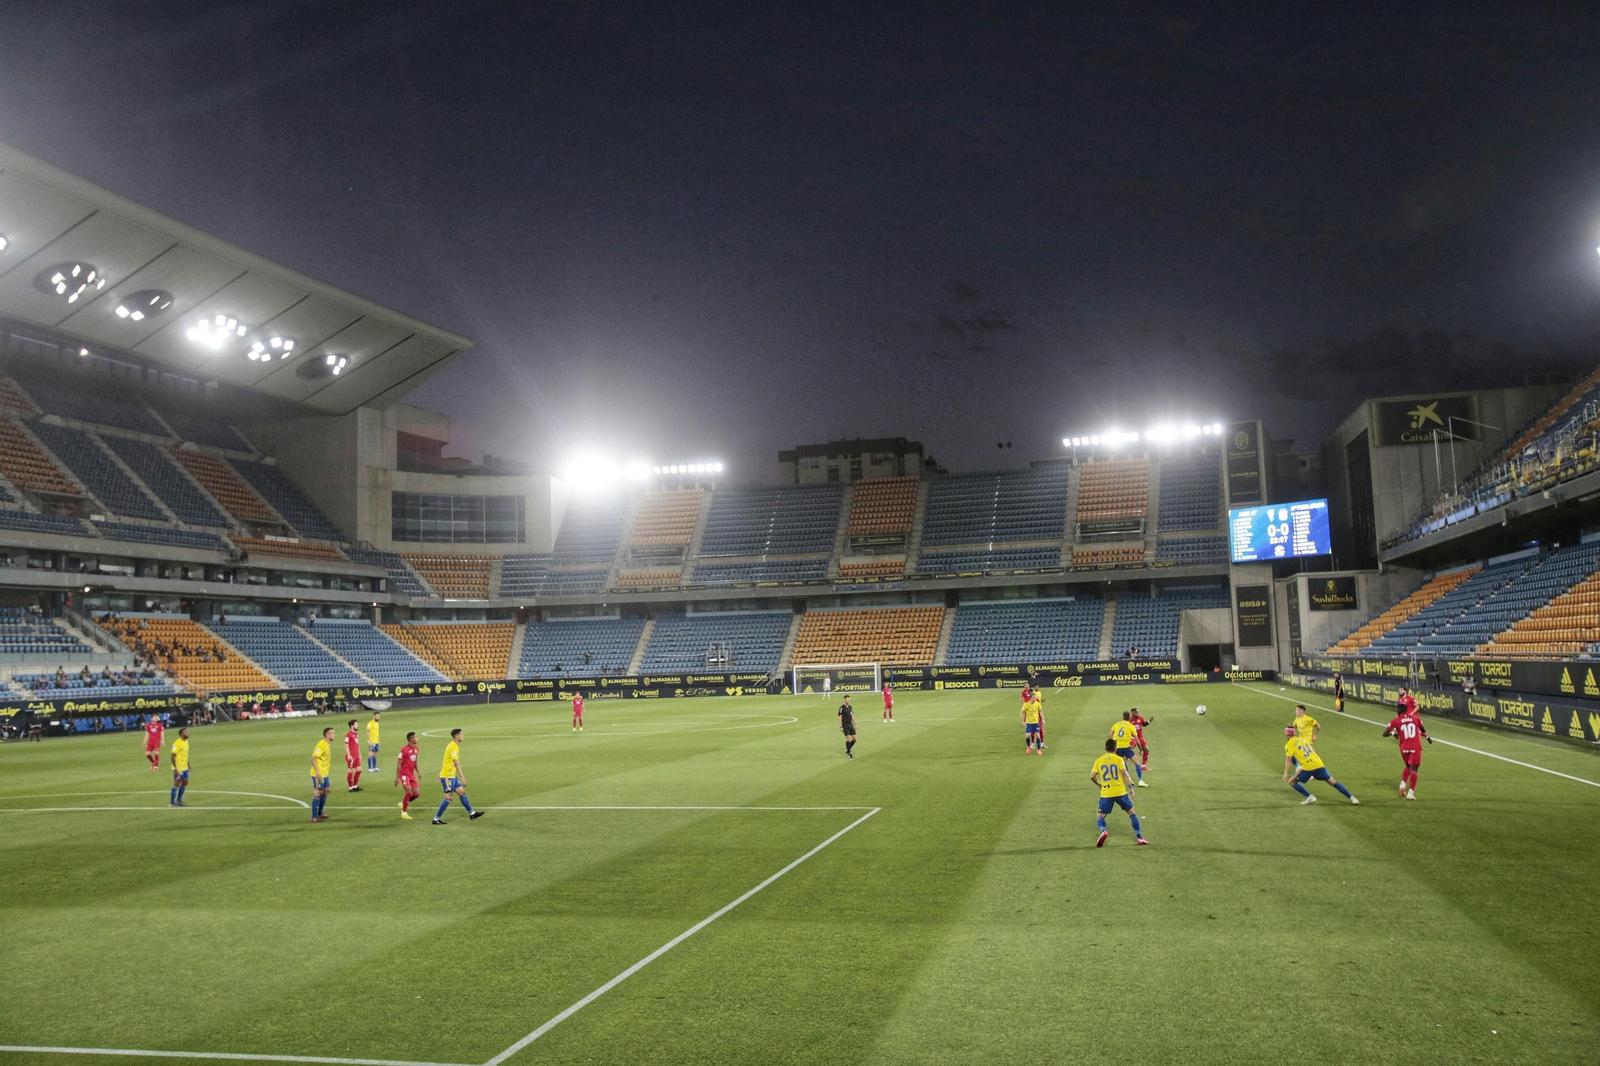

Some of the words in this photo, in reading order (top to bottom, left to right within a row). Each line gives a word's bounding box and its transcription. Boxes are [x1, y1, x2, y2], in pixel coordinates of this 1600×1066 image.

[1401, 432, 1451, 442] CaixaBank
[1267, 523, 1290, 537] 0-0
[1312, 594, 1353, 603] SushiPanda
[1480, 663, 1512, 676] TORROT
[1100, 673, 1150, 681] SPAGNOLO
[487, 683, 505, 692] LaLiga
[1560, 684, 1575, 693] adidas
[1584, 686, 1599, 696] adidas
[1468, 697, 1496, 720] Cruzcampo
[1498, 700, 1534, 717] TORROT
[1118, 727, 1125, 738] 6
[1400, 723, 1416, 739] 10
[1541, 724, 1555, 733] adidas
[1569, 728, 1584, 739] adidas
[1297, 743, 1313, 757] 34
[1101, 764, 1119, 781] 20
